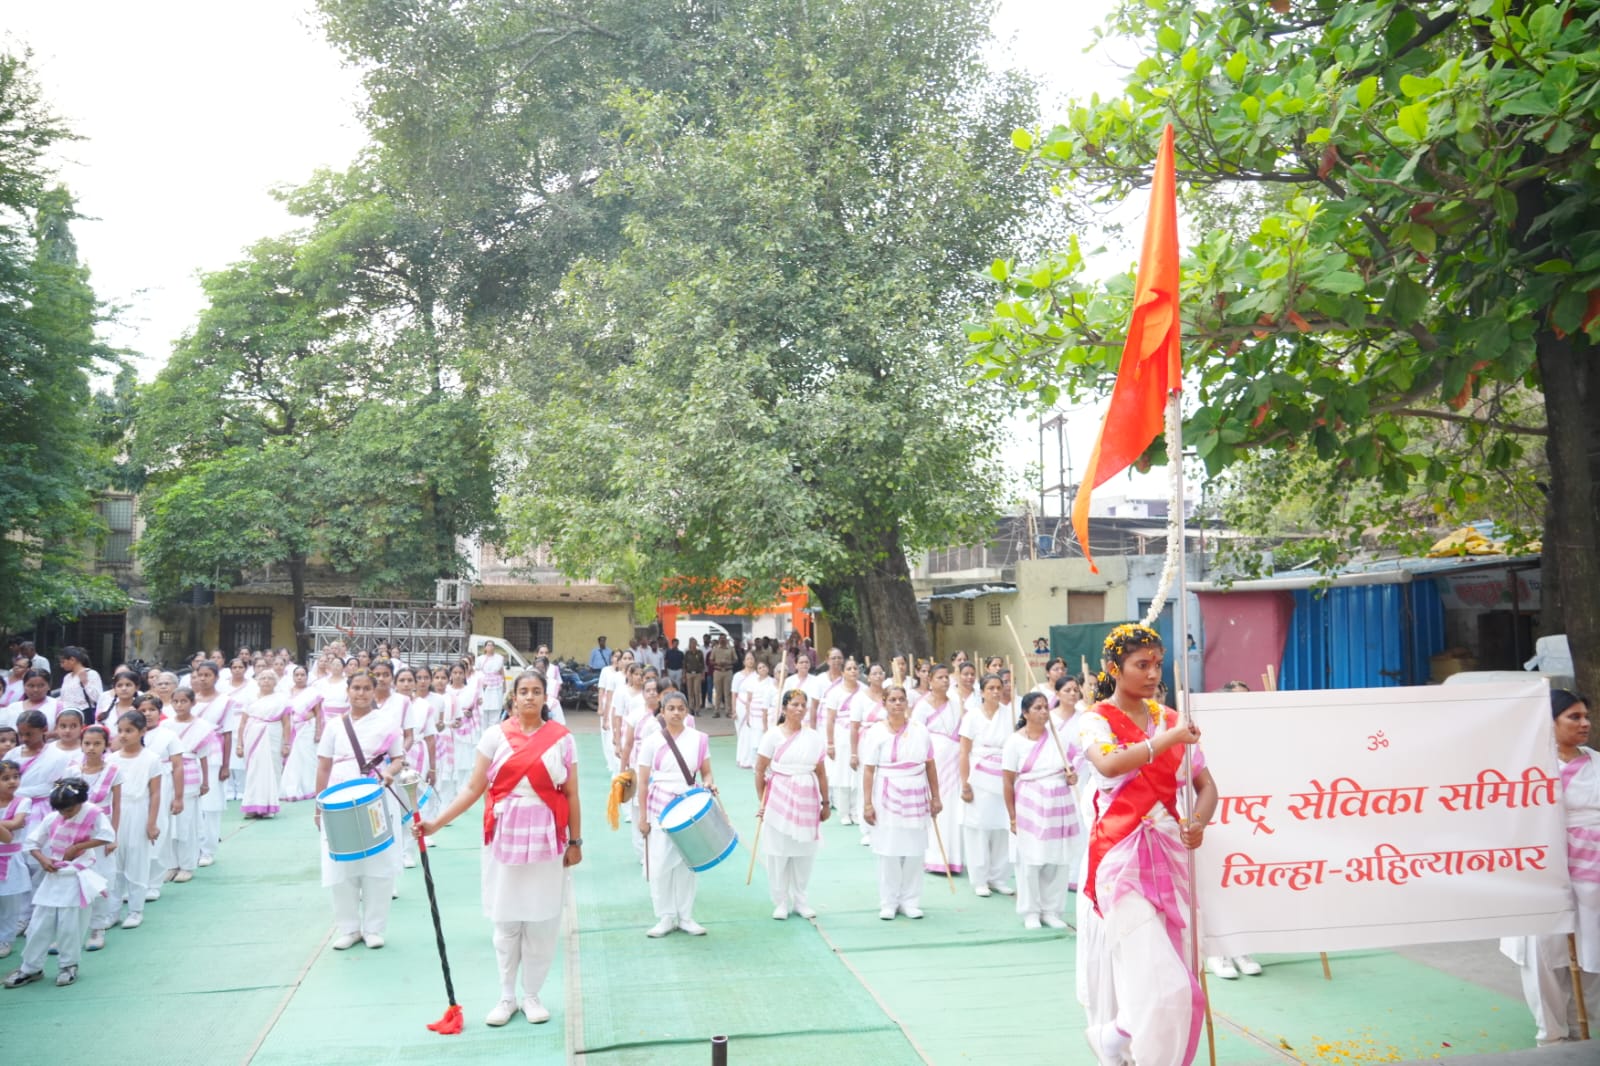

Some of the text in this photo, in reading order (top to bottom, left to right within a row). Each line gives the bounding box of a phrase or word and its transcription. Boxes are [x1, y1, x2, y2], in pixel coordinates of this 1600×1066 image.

[1207, 766, 1560, 835] ाष्ट्र सेविका समिति
[1220, 843, 1548, 891] जिल्हा-अहिल्यानगर
